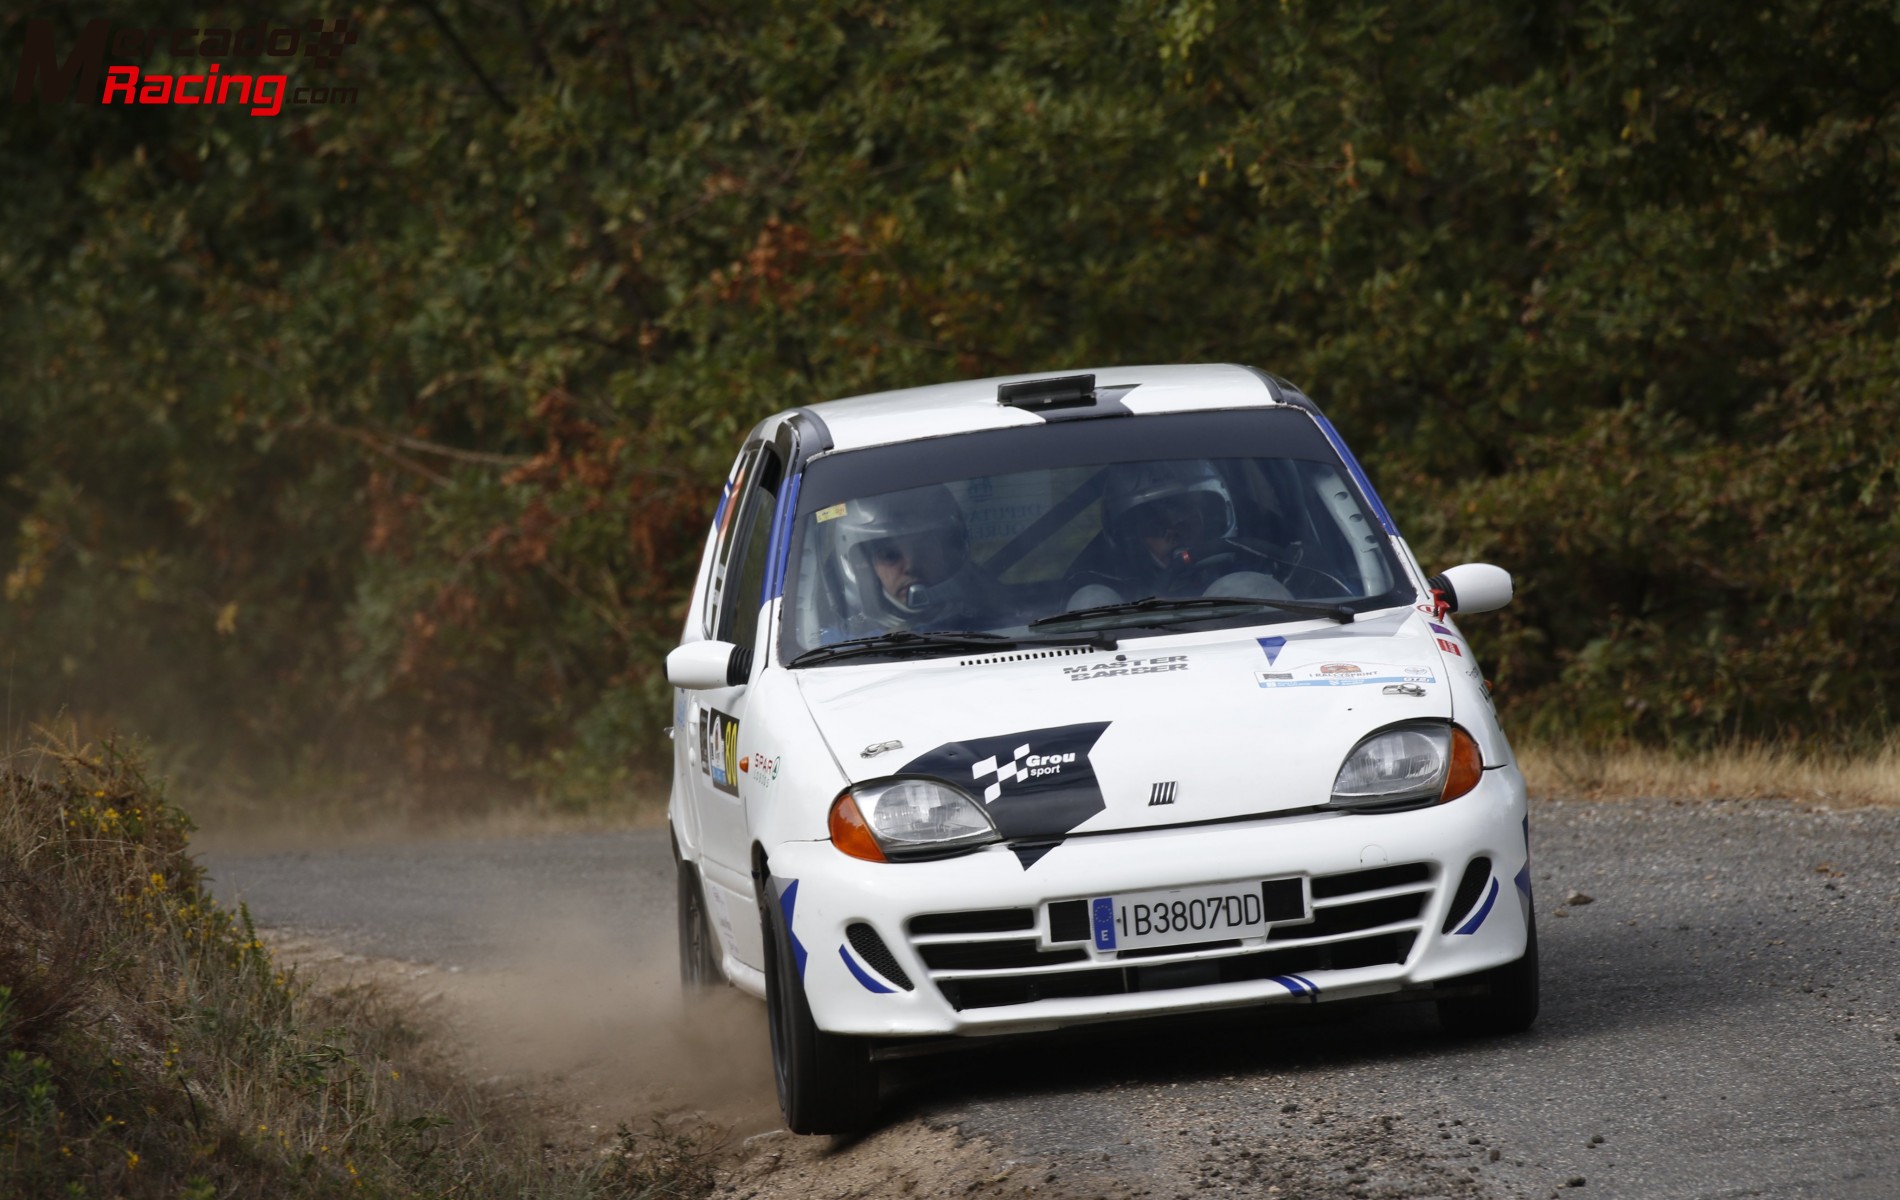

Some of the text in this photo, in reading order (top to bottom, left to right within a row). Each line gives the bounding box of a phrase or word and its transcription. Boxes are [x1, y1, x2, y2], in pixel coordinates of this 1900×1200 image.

[1063, 655, 1189, 674] MASTER
[1026, 752, 1076, 767] Grou
[1030, 764, 1061, 777] sport
[1121, 894, 1261, 937] IB3807DD
[1101, 930, 1109, 941] E
